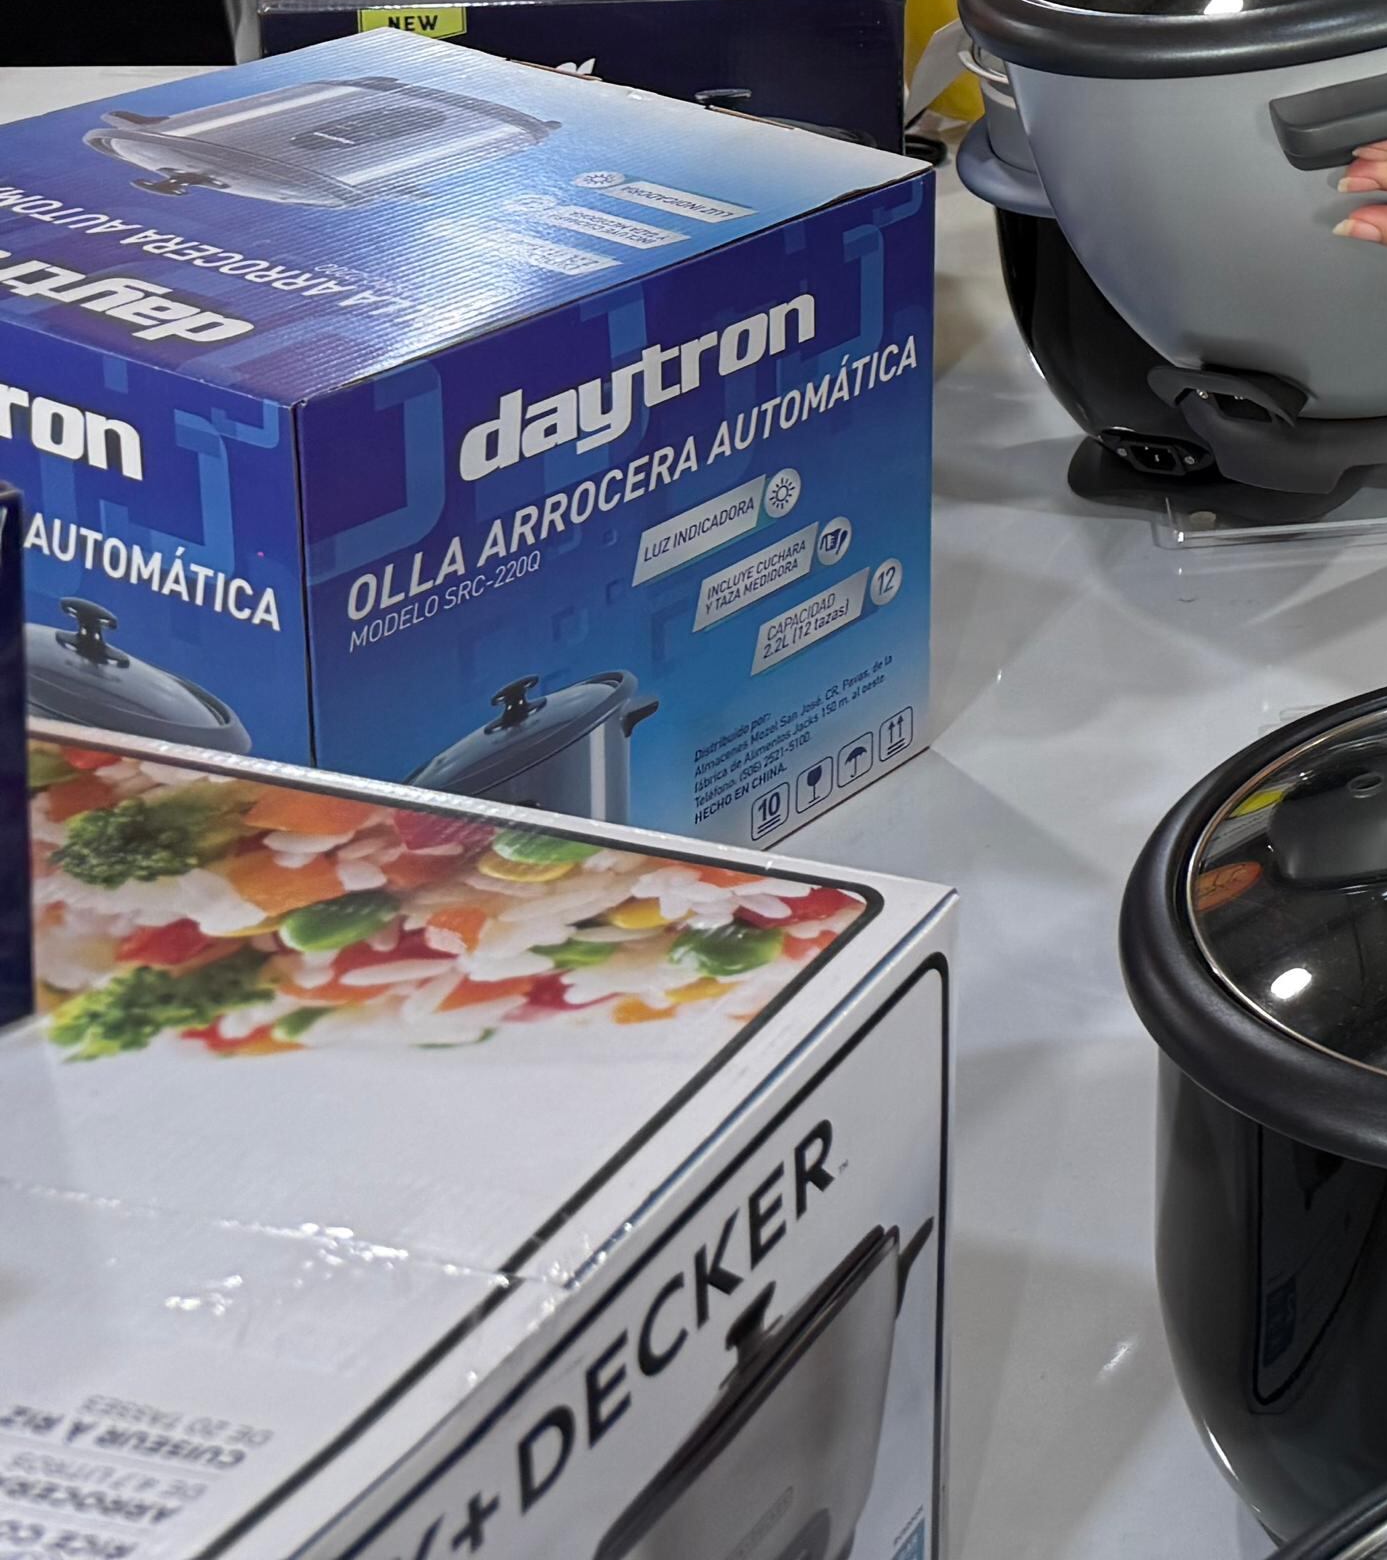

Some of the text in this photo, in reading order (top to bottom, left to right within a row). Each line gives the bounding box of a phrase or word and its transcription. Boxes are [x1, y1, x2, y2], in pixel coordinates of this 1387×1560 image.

[387, 14, 440, 34] NEW
[0, 249, 256, 343] daytr
[119, 227, 357, 298] ARROCERA
[458, 292, 818, 484] daytron
[345, 333, 920, 622] OLLA ARROCERA AUTOMÁTICA
[642, 496, 756, 564] LUZ INDICADORA
[23, 511, 282, 633] AUTOMÁTICA
[347, 550, 545, 654] MODELO SRC-220Q
[705, 557, 800, 617] Y TAZA MEDIDORA
[706, 539, 807, 601] INCLUYE CUCHARA
[766, 564, 897, 642] CAPACIDAD 12
[693, 741, 749, 779] Almacenes
[780, 711, 799, 729] San
[872, 658, 884, 675] de
[693, 711, 772, 764] Distribuido por:
[729, 759, 743, 775] de
[743, 729, 792, 765] Alimentos
[792, 714, 820, 738] Jacks
[693, 795, 733, 826] HECHO
[733, 784, 751, 802] EN
[757, 791, 782, 823] 10
[94, 1425, 247, 1471] CUISEUR
